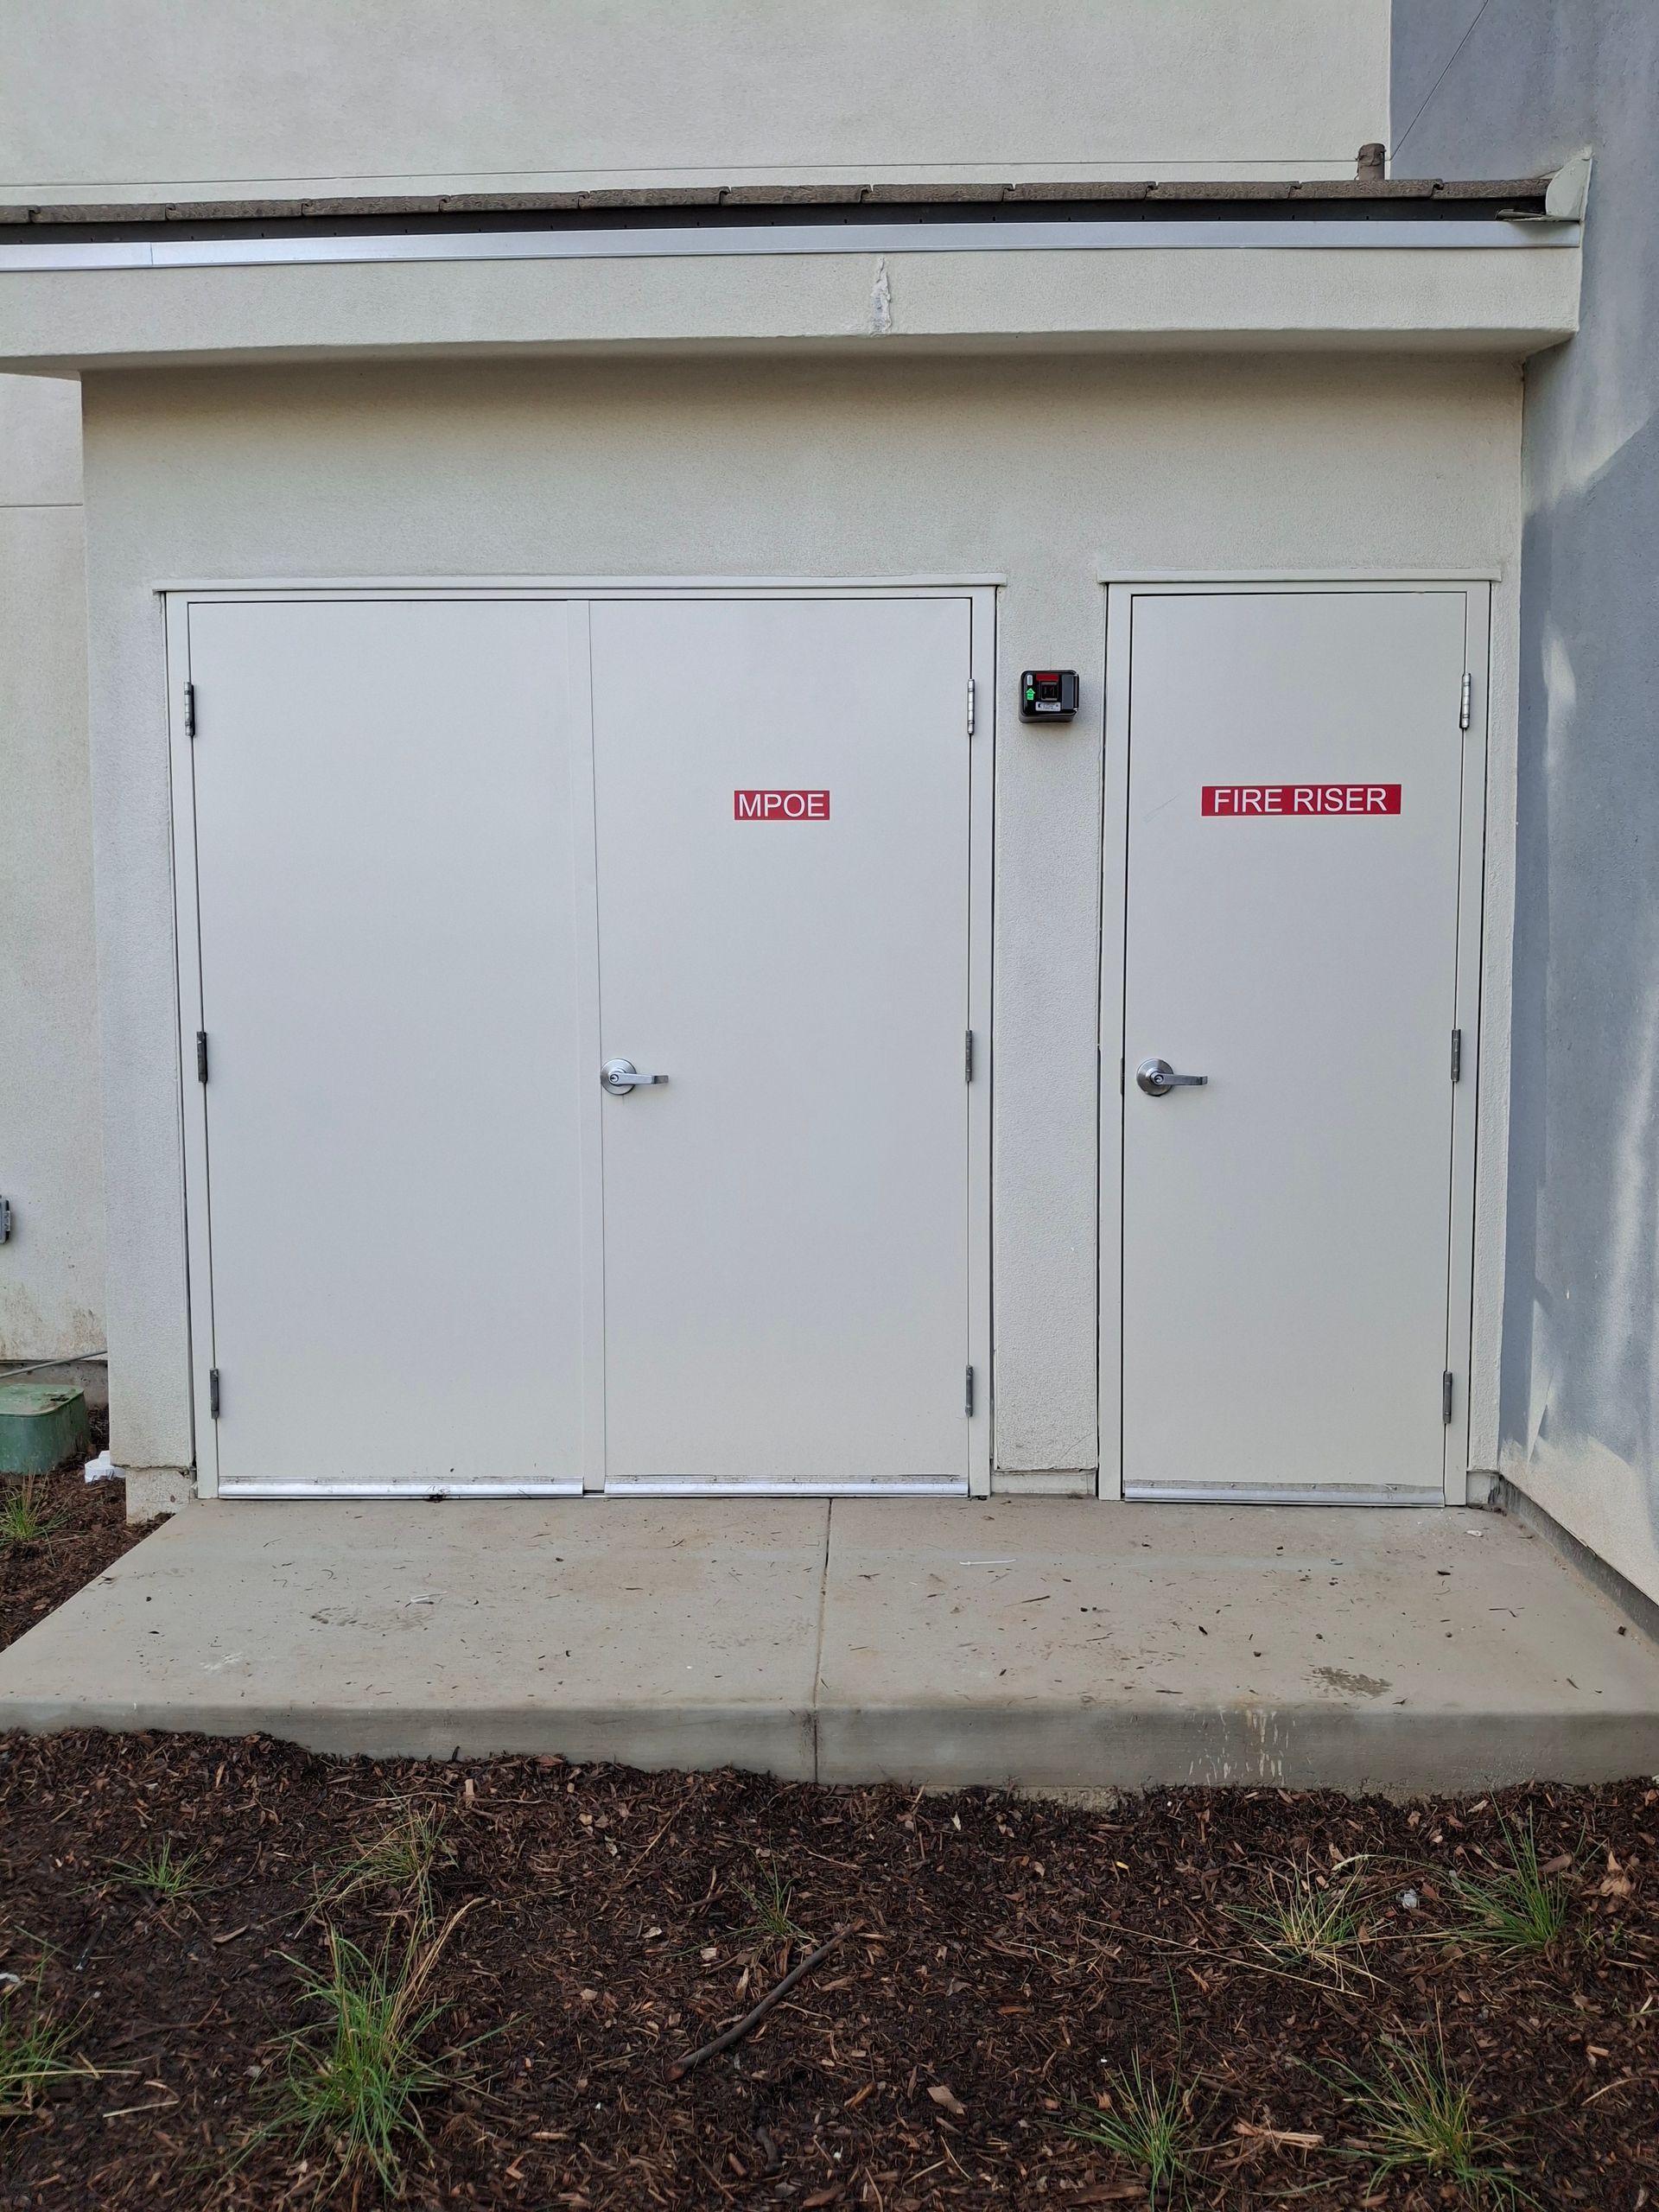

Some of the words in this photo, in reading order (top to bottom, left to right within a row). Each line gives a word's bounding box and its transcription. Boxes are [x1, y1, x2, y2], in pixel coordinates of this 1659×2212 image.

[739, 793, 825, 817] MPOE
[1214, 788, 1282, 813] FIRE
[1294, 787, 1388, 812] RISER
